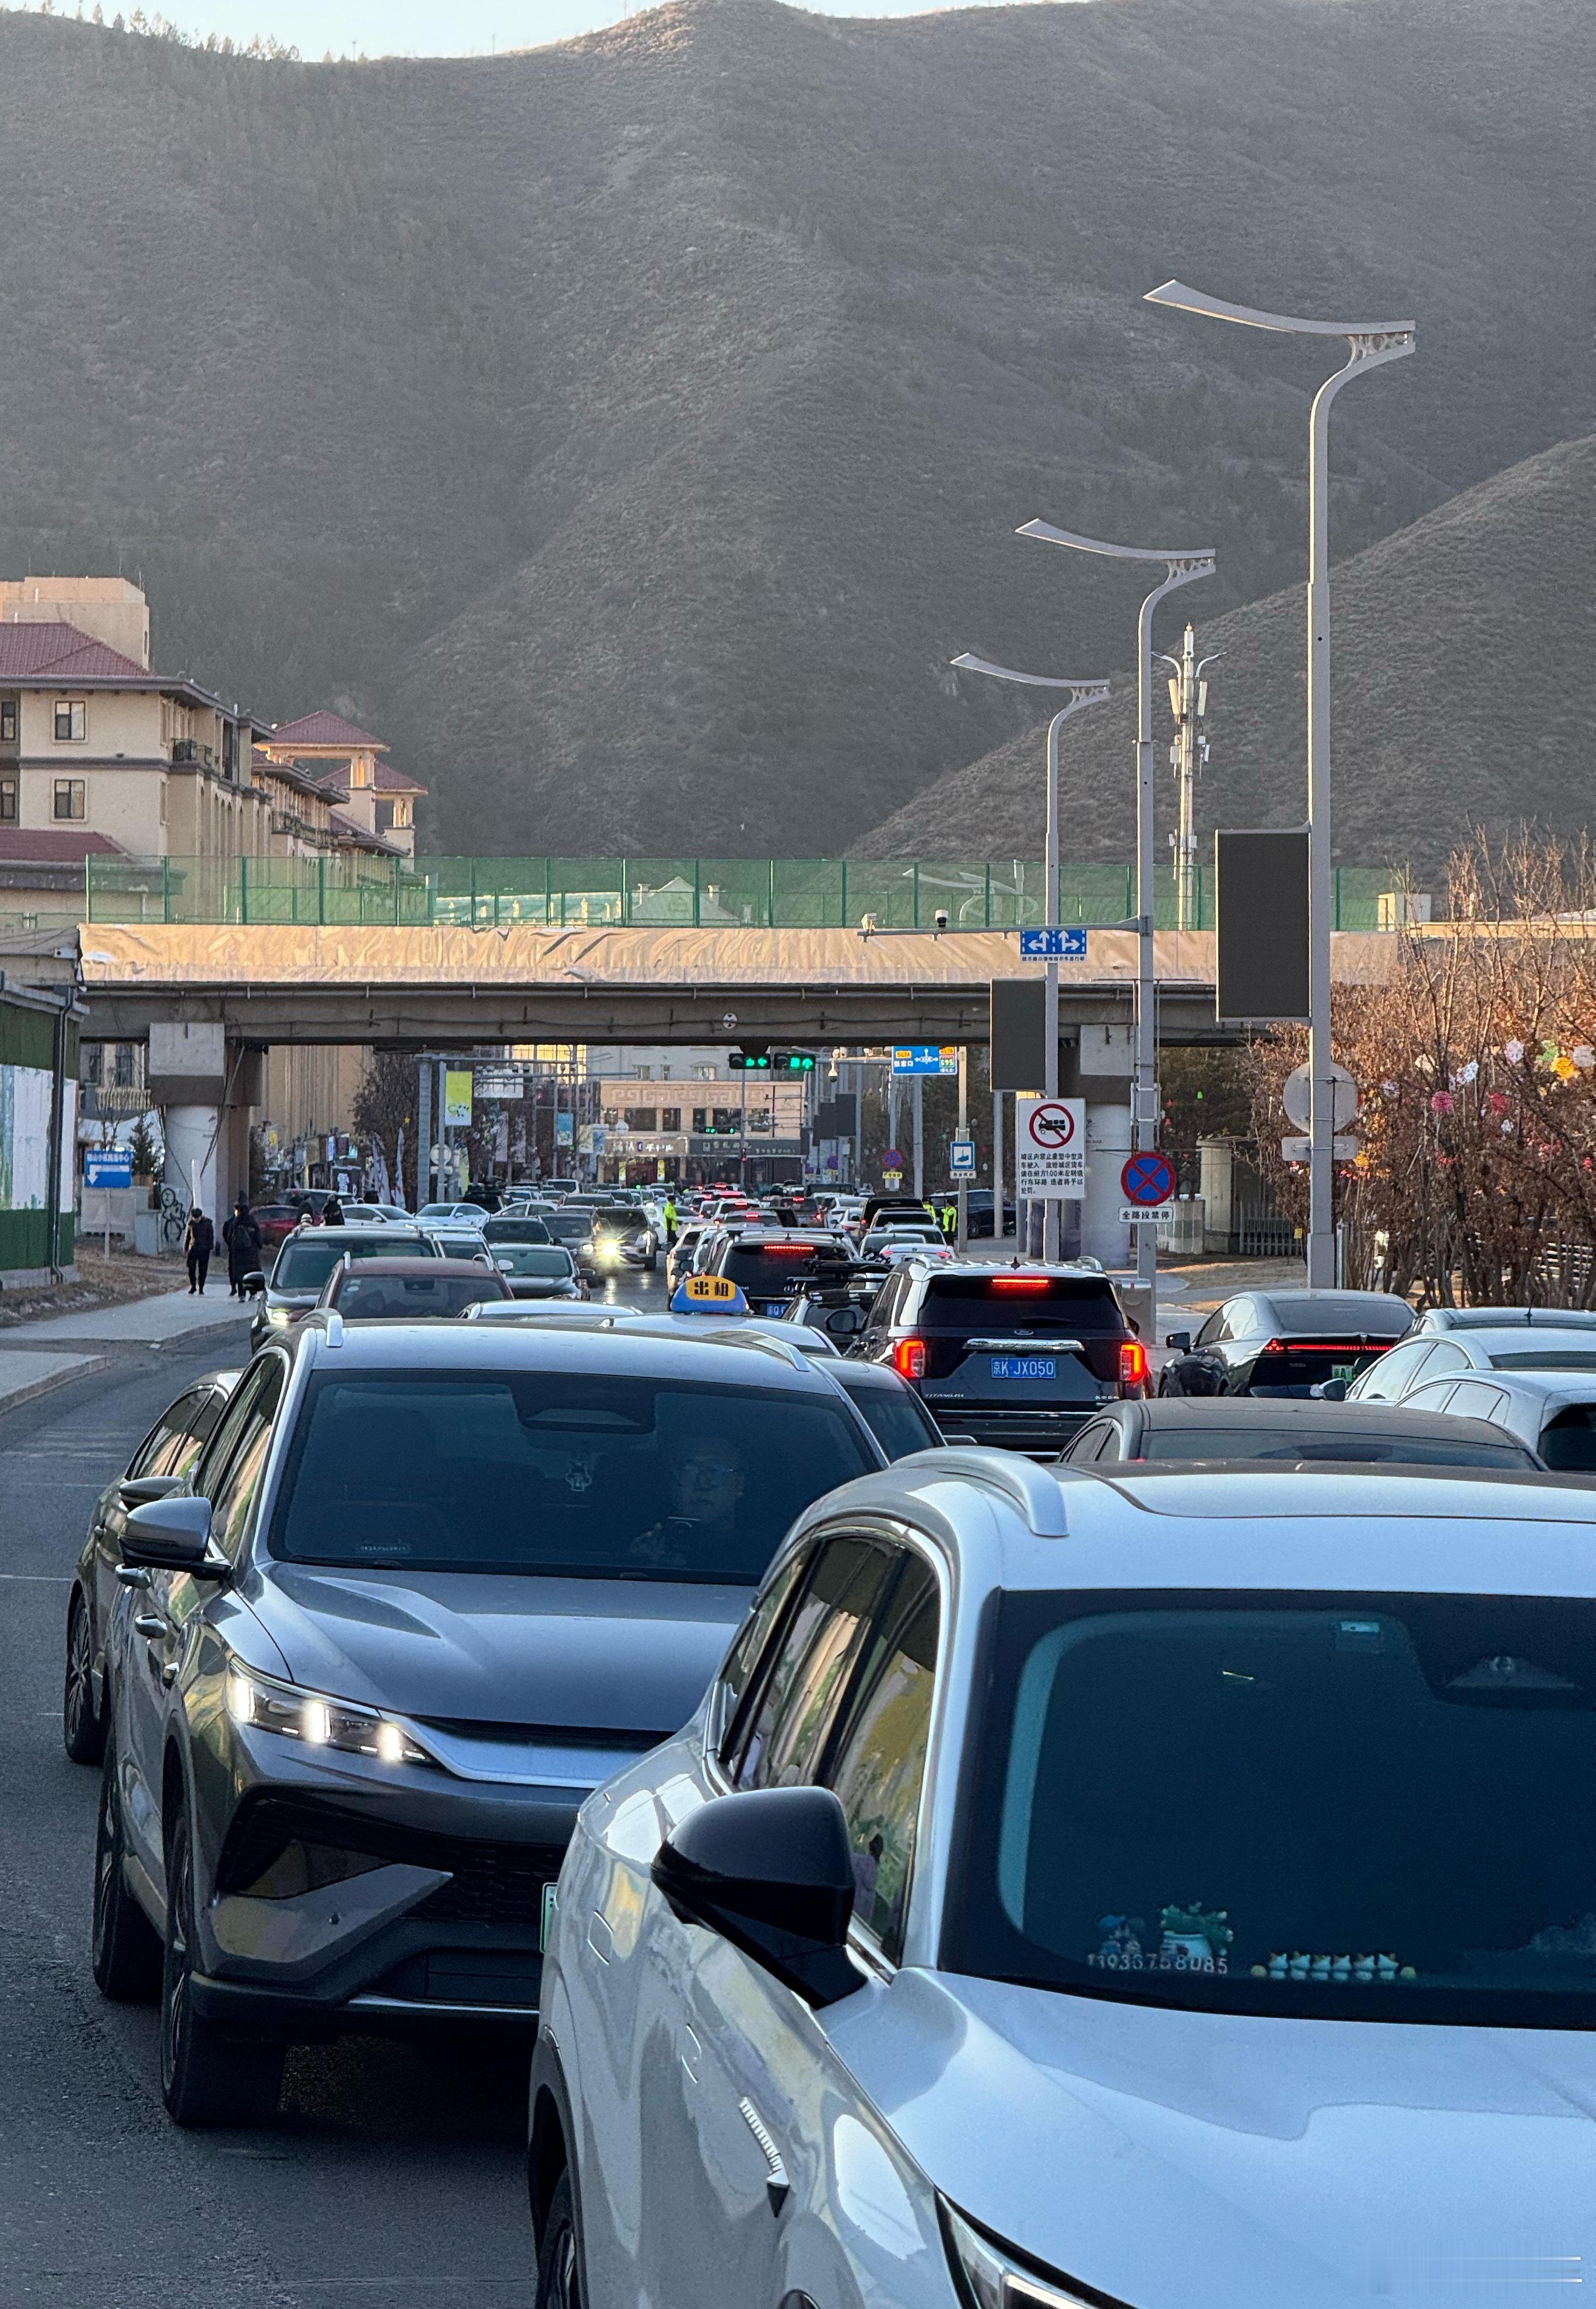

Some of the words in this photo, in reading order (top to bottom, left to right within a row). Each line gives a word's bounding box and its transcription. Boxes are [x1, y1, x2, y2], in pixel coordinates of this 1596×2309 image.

[1122, 1210, 1170, 1220] 全路段禁停
[694, 1281, 729, 1297] 出租
